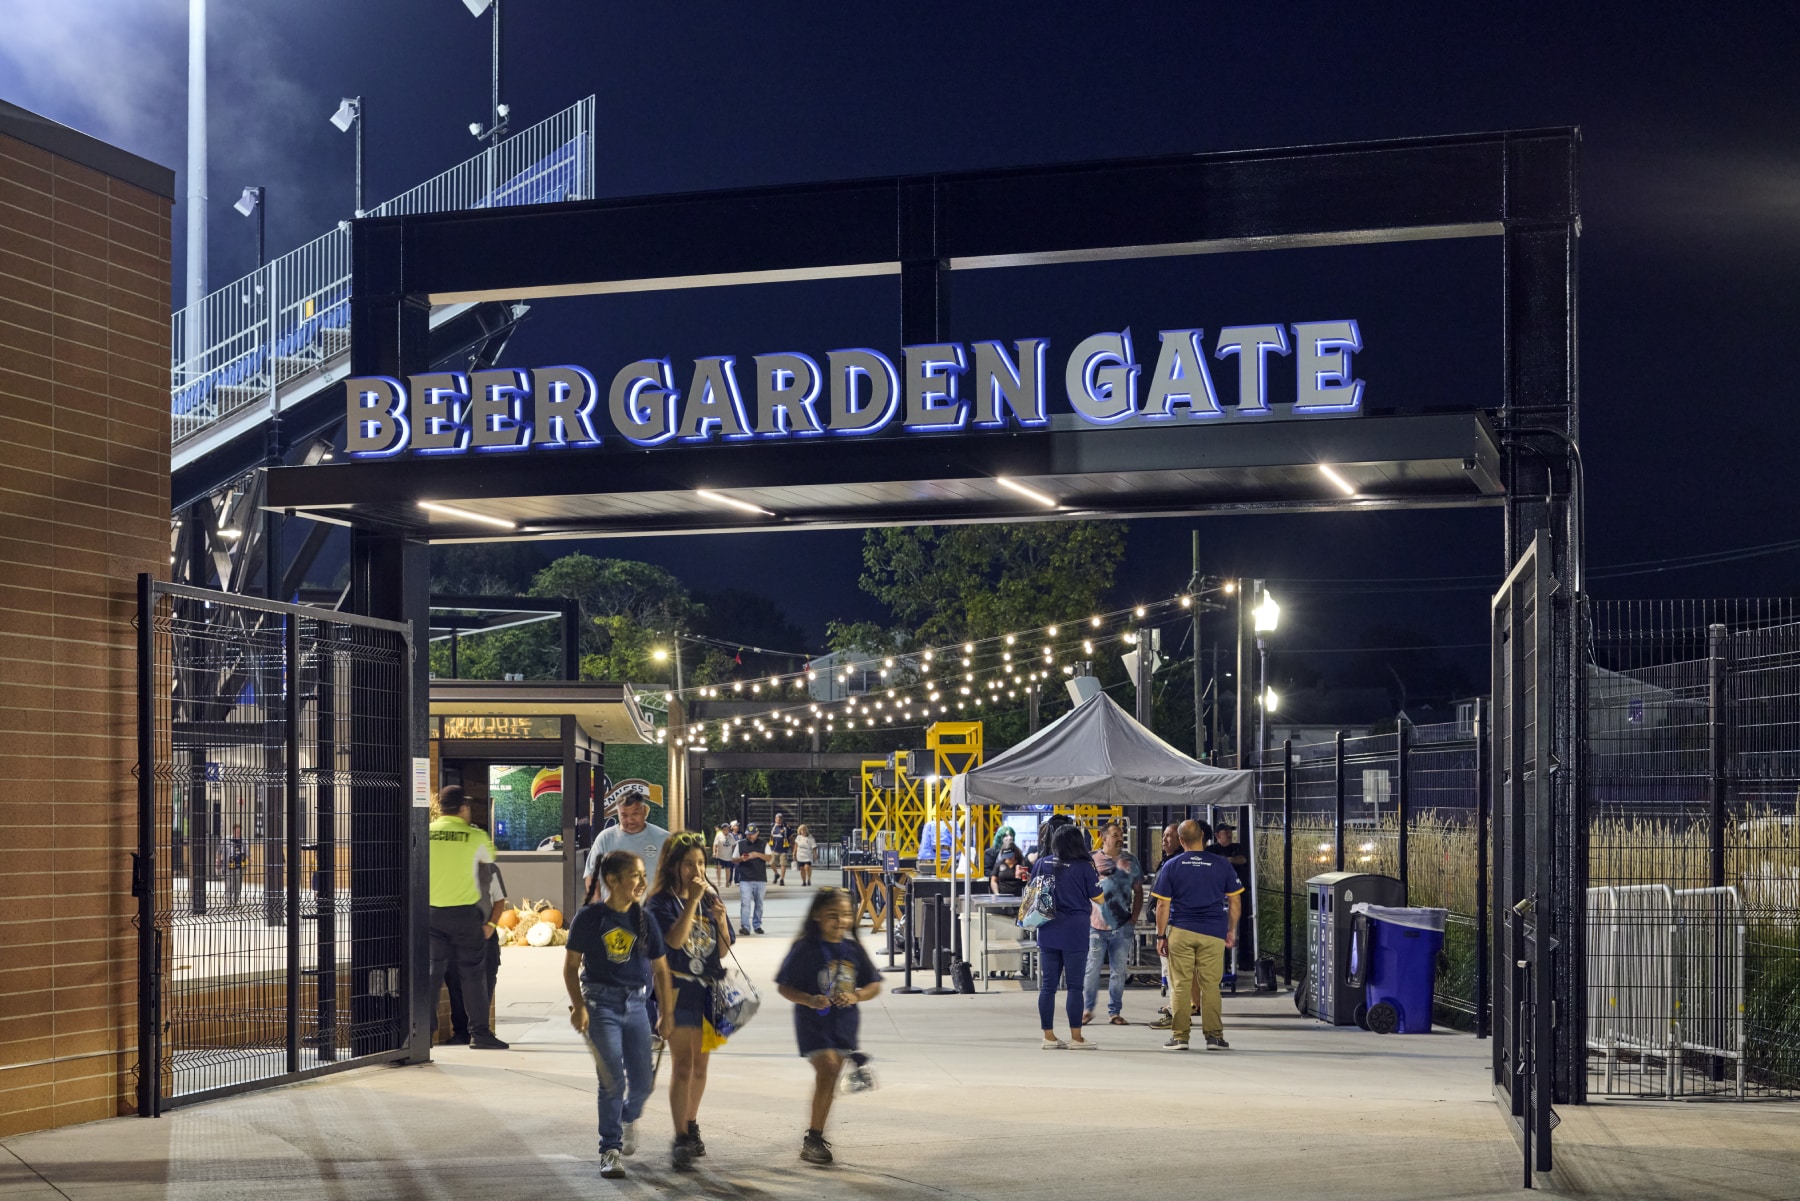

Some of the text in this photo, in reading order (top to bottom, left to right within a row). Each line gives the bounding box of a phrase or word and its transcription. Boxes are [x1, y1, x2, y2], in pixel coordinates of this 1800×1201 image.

[345, 319, 1366, 458] BEER GARDEN GATE
[429, 830, 471, 842] SECURITY
